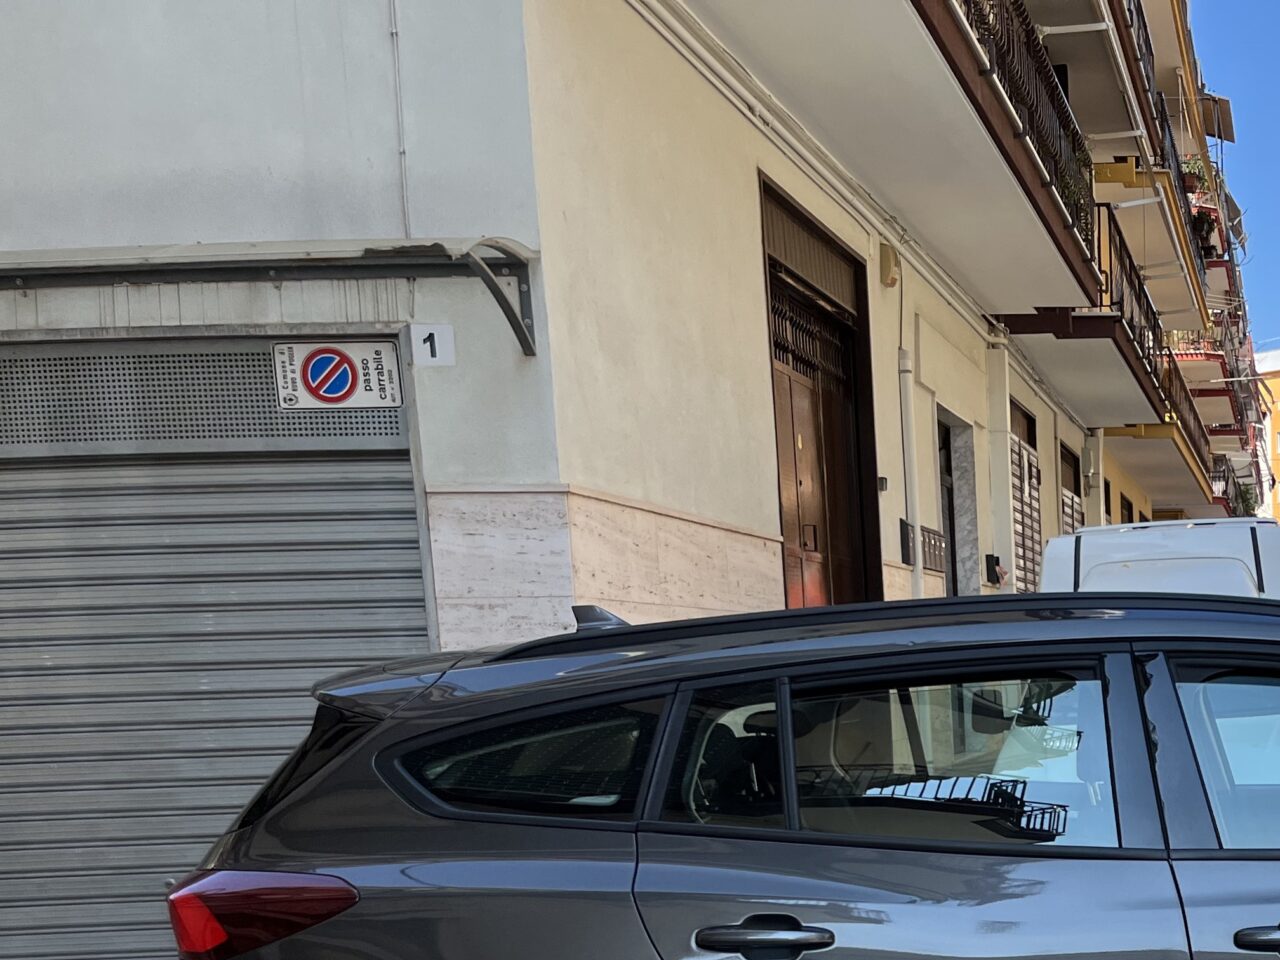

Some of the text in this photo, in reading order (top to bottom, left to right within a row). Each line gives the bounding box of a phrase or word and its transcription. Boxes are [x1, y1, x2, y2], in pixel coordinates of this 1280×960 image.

[423, 332, 437, 358] 1
[361, 358, 373, 392] passo
[374, 350, 387, 400] carrabile
